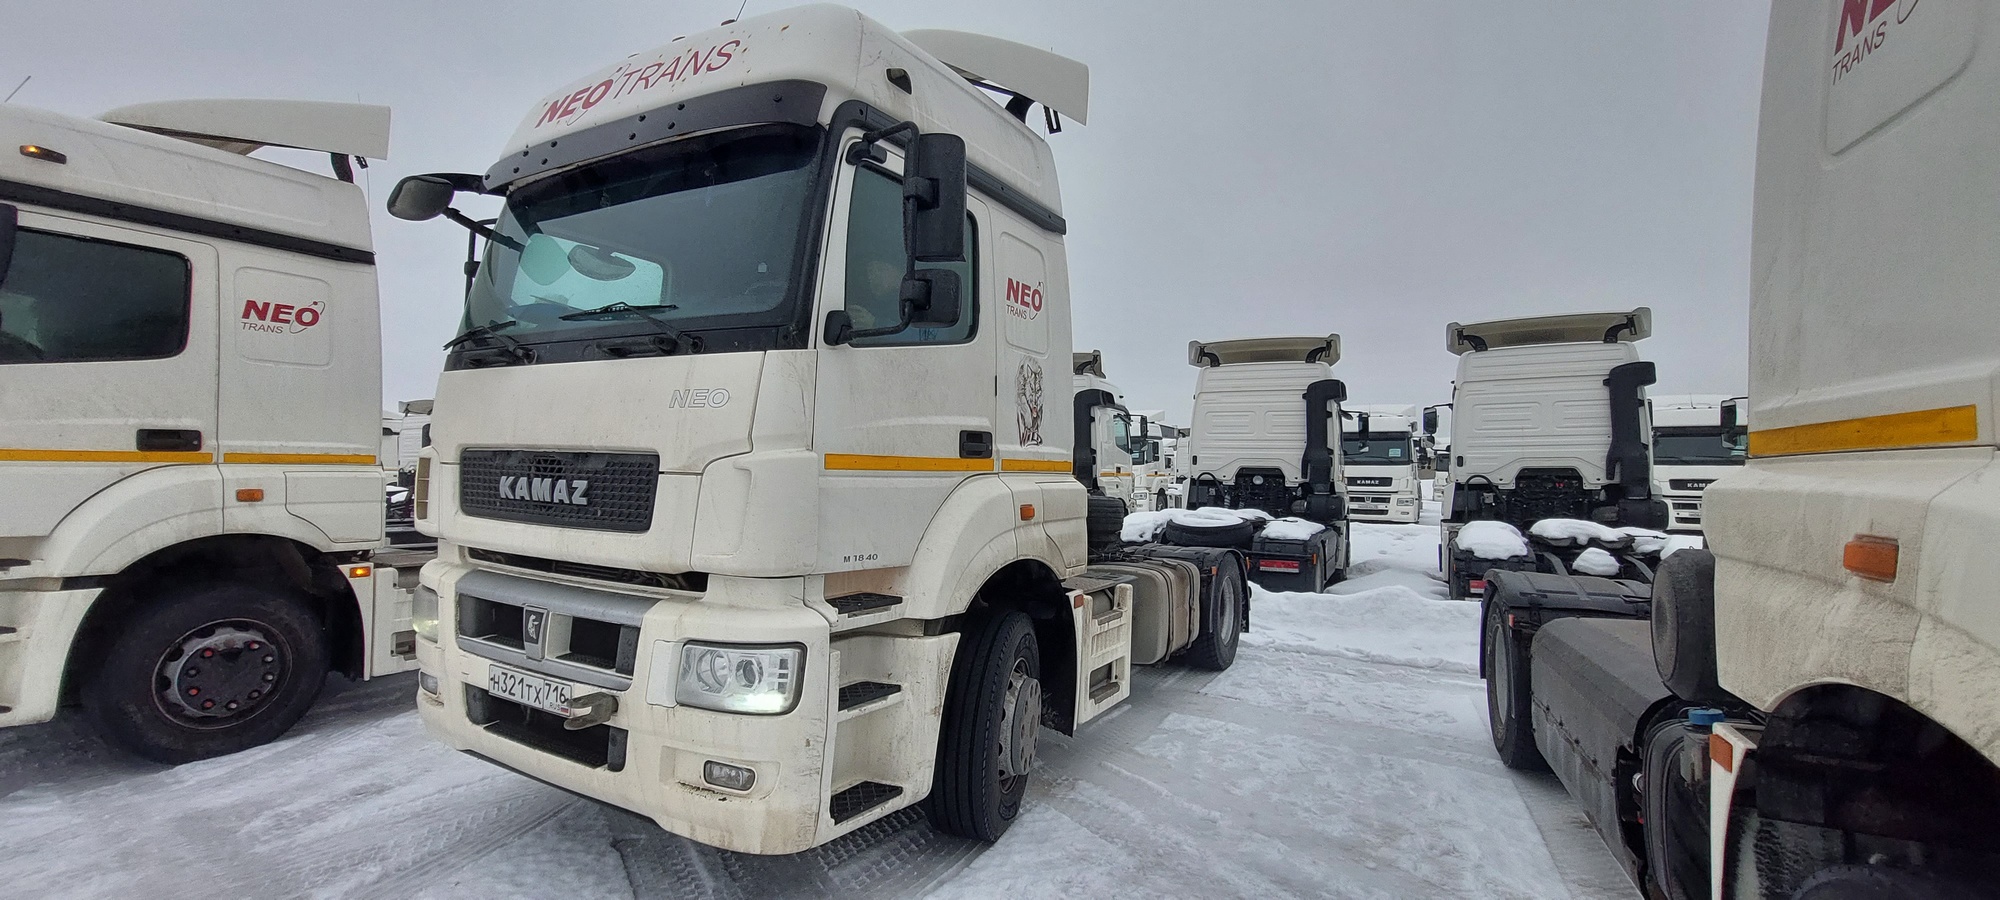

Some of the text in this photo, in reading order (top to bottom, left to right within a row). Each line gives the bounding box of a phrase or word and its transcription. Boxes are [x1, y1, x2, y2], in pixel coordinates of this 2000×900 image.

[1833, 21, 1887, 85] TRANS
[534, 39, 741, 129] NEO TRANS
[1006, 277, 1043, 313] NEO
[241, 299, 320, 327] NEO
[1006, 304, 1027, 320] TRANS
[241, 321, 284, 334] TRANS
[669, 388, 730, 409] NEO
[500, 475, 588, 505] KAMAZ
[545, 682, 569, 704] 716
